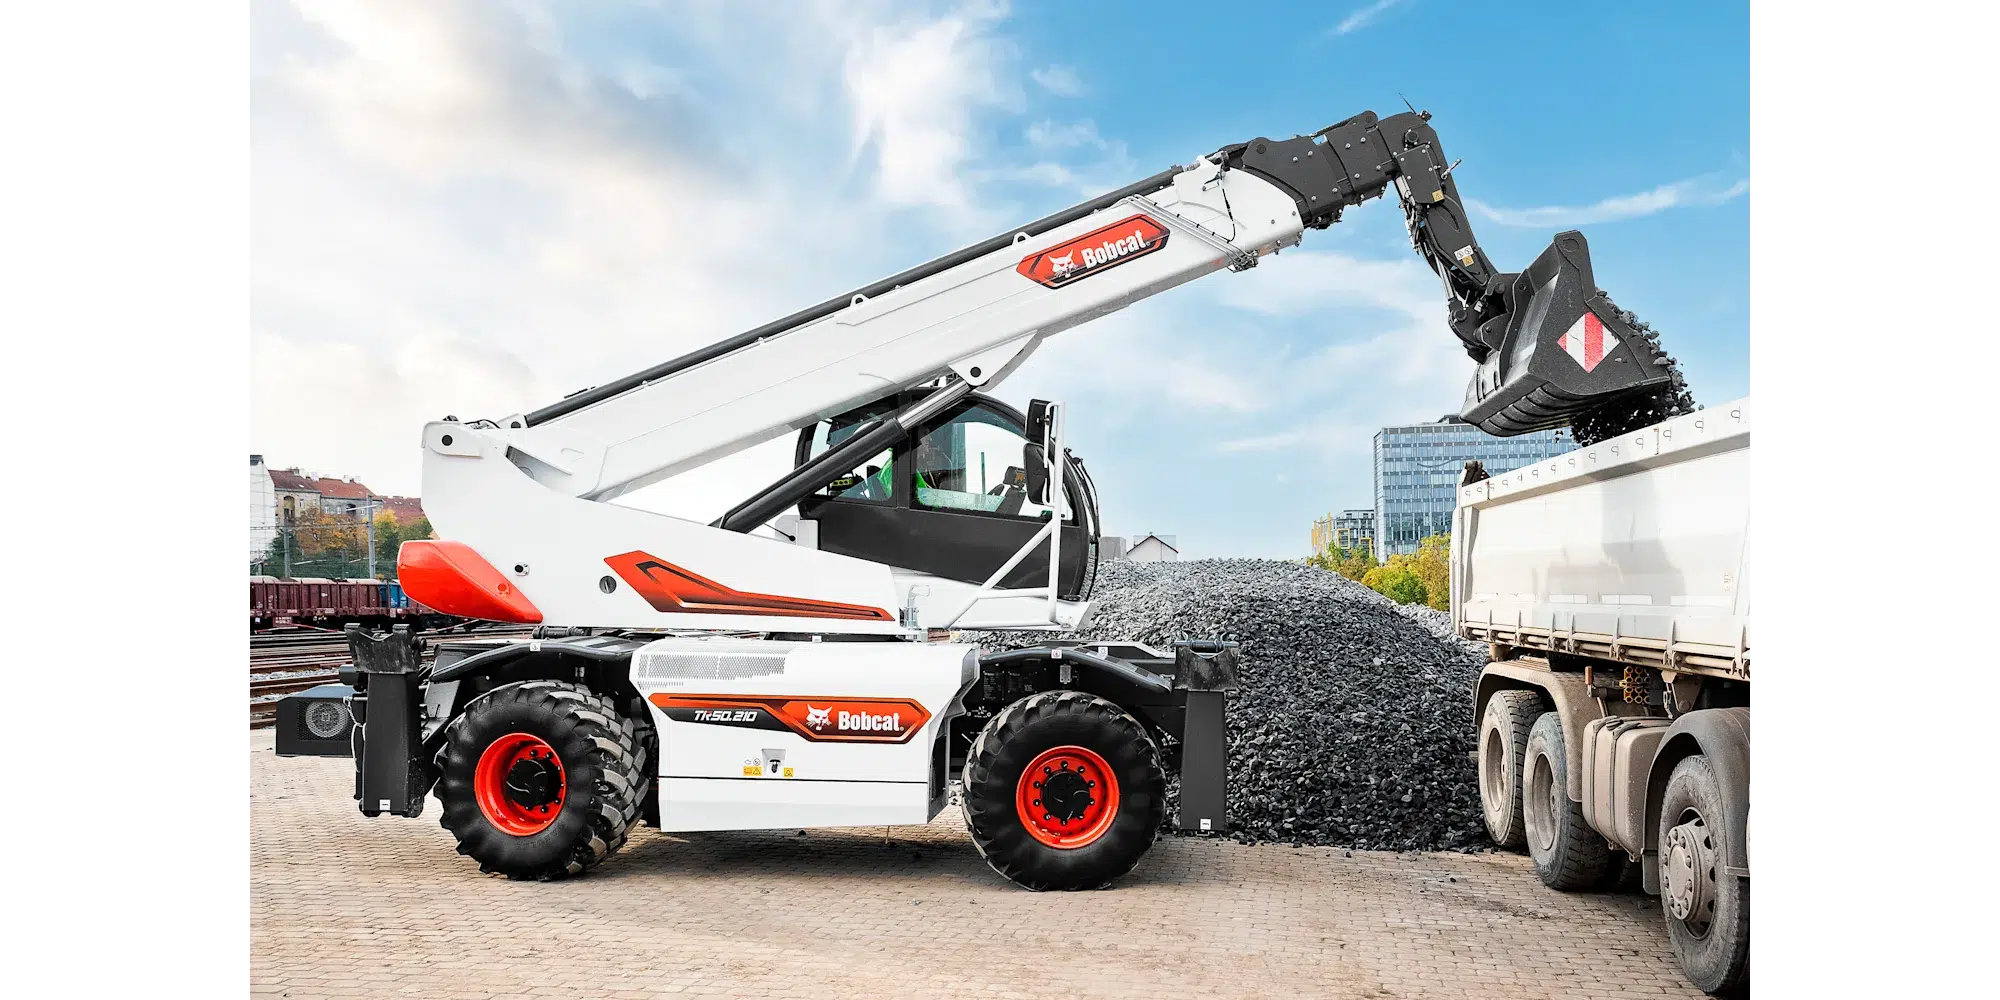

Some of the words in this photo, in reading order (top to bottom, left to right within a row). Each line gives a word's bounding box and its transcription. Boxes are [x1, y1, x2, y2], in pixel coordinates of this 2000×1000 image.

[1081, 229, 1145, 268] Bobcat
[694, 710, 758, 722] TR50.210
[838, 711, 901, 731] Bobcat
